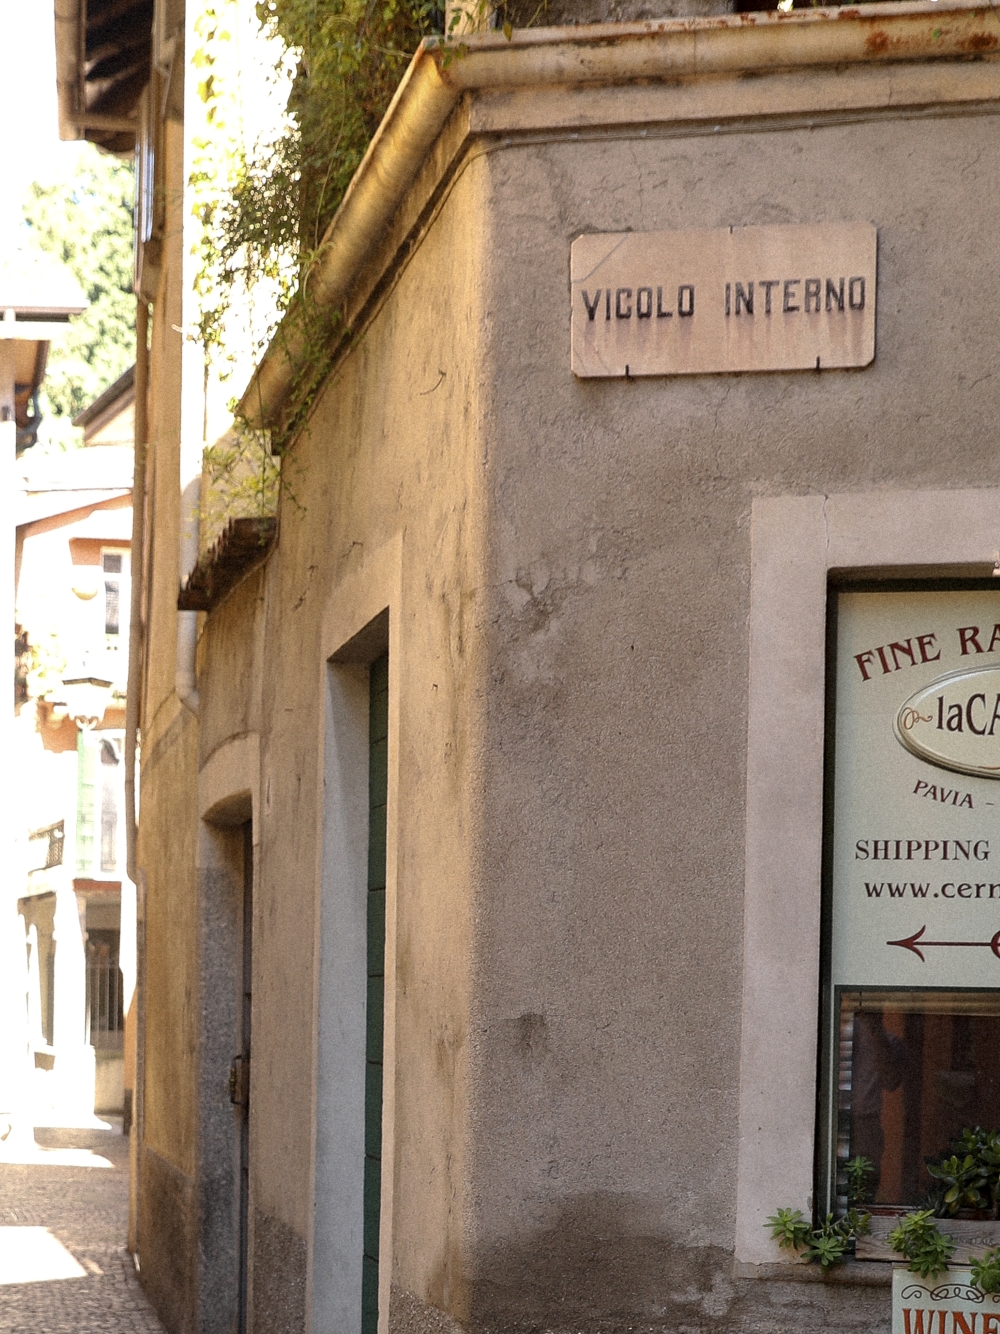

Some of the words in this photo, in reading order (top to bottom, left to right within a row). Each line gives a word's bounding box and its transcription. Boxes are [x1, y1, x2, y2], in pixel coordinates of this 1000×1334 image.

[581, 284, 695, 321] VICOLO
[724, 276, 867, 317] INTERNO
[853, 632, 942, 682] FINE
[912, 779, 974, 809] PAVIA
[854, 839, 992, 861] SHIPPING
